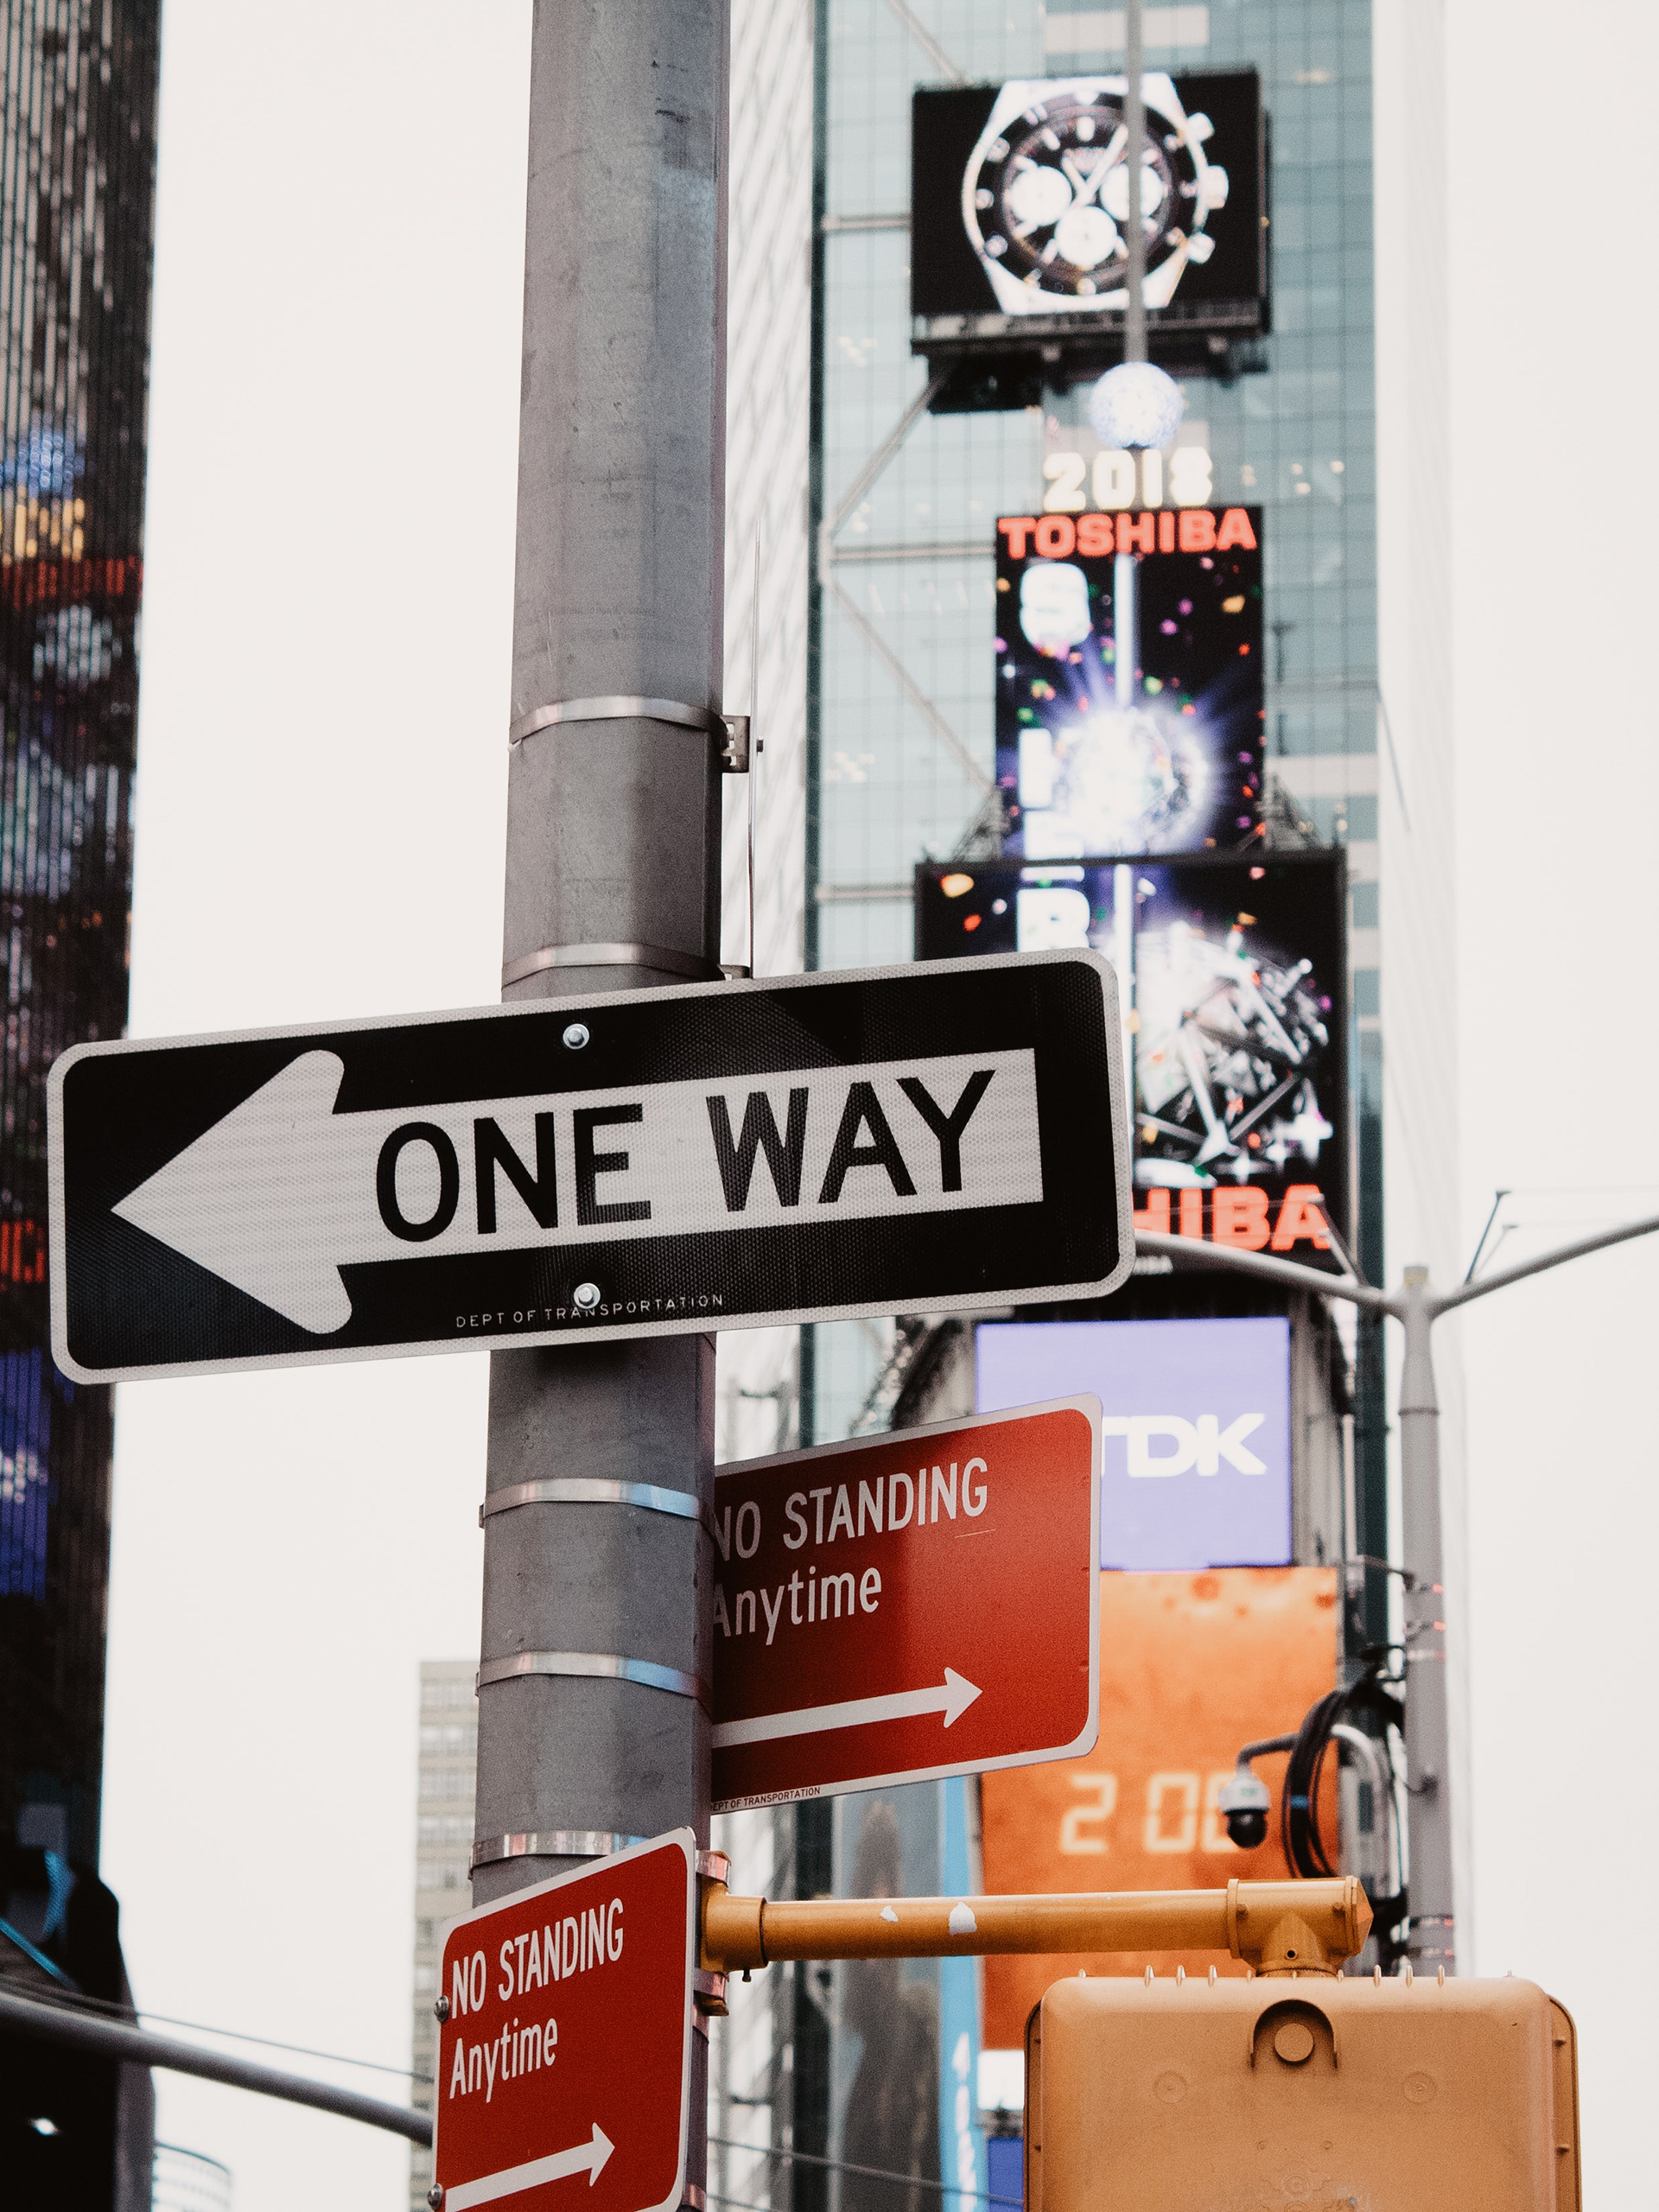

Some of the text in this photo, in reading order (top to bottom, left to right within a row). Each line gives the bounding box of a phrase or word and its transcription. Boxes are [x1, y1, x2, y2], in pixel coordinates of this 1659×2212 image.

[1043, 447, 1212, 512] 2018
[997, 508, 1257, 559] TOSHIBA
[376, 1070, 996, 1243] ONE WAY
[1132, 1185, 1331, 1251] HIBA
[456, 1294, 724, 1328] DEPT OF TRANSPORTATION
[714, 1457, 988, 1561] NO STANDING
[713, 1567, 882, 1645] Anytime
[711, 1786, 821, 1812] EPT OF TRANSPORTATION
[451, 1897, 624, 2019] NO STANDING
[448, 2018, 558, 2103] Anytime
